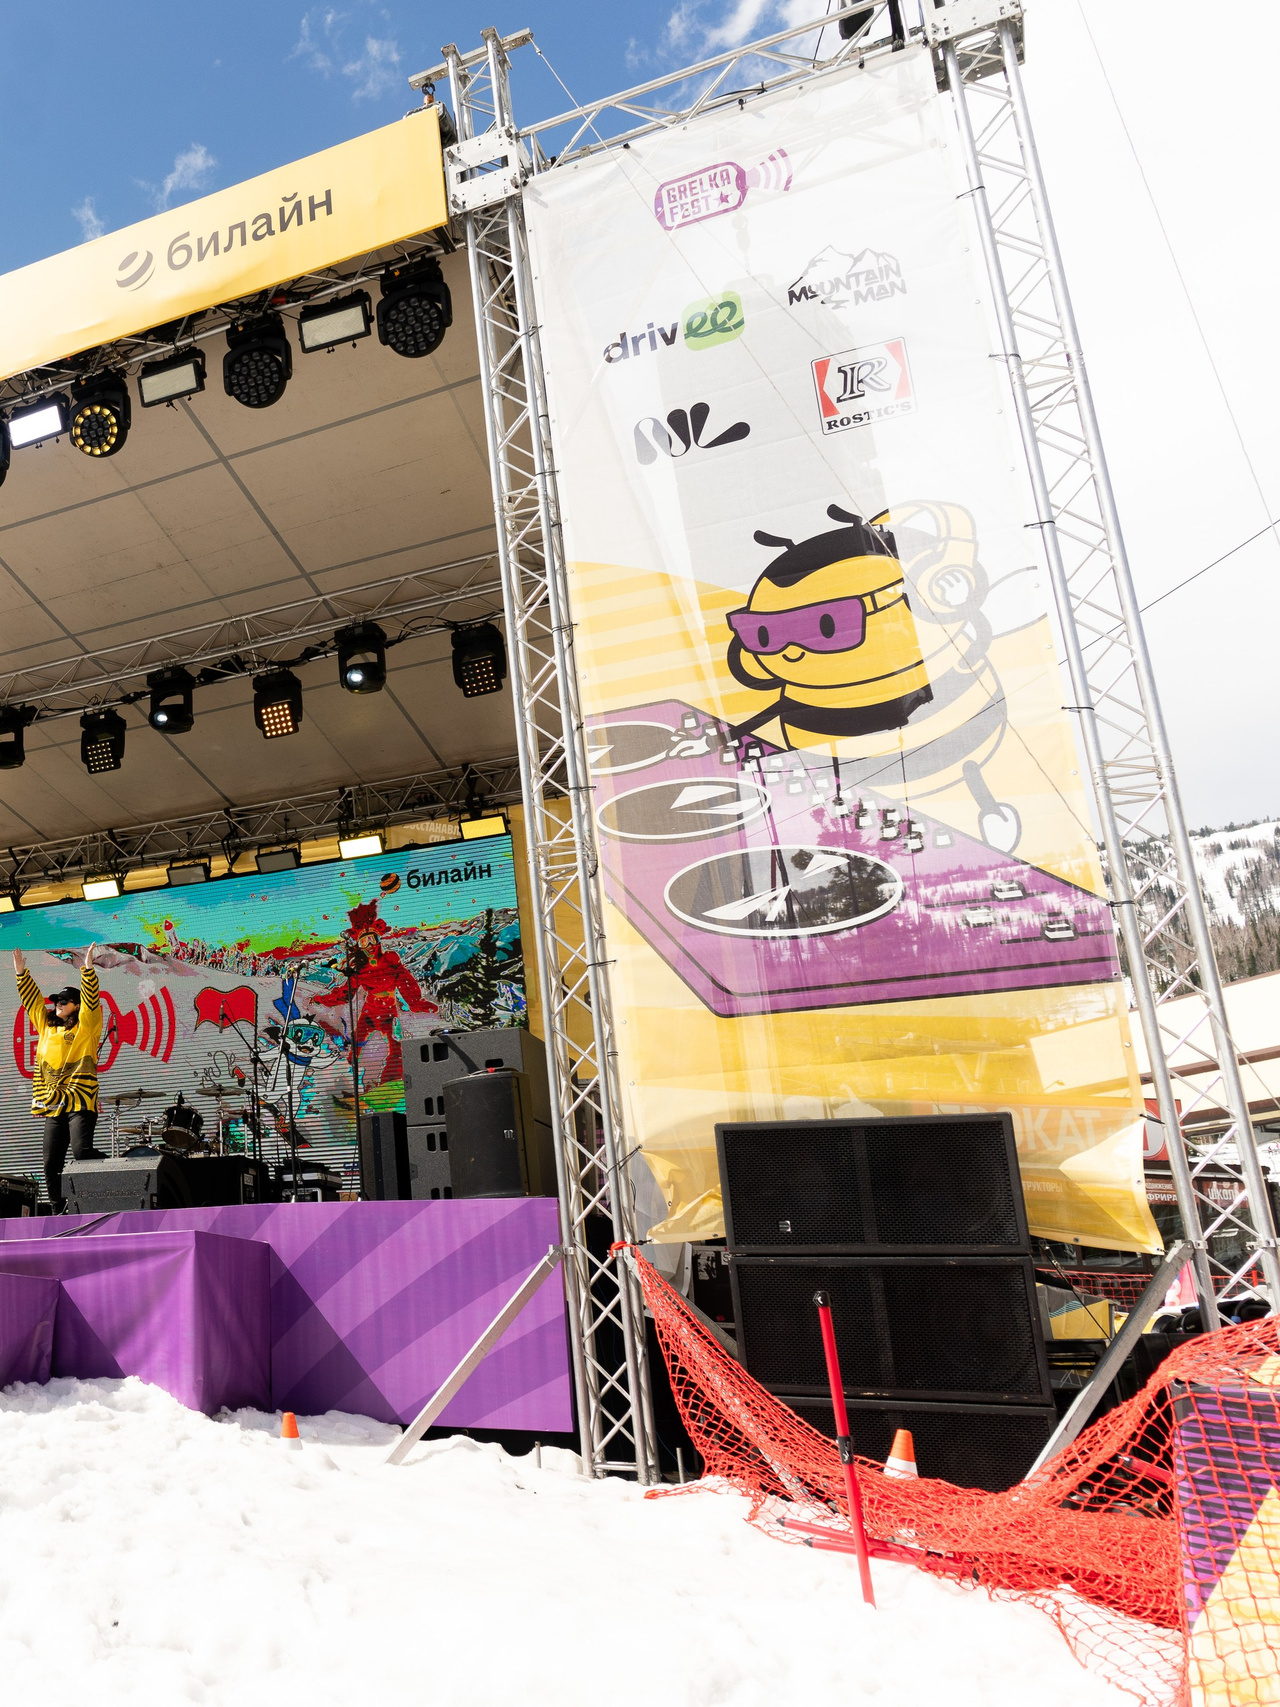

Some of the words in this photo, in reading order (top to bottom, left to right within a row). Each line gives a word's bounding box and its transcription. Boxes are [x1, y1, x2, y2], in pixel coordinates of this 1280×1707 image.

[666, 168, 731, 205] GRELKA
[669, 195, 712, 223] FEST
[167, 189, 333, 271] билайн
[787, 262, 902, 306] MOUNTAIN
[854, 279, 908, 306] MAN
[603, 301, 745, 364] drivee
[826, 401, 912, 430] ROSTIC'S
[406, 861, 492, 889] билайн
